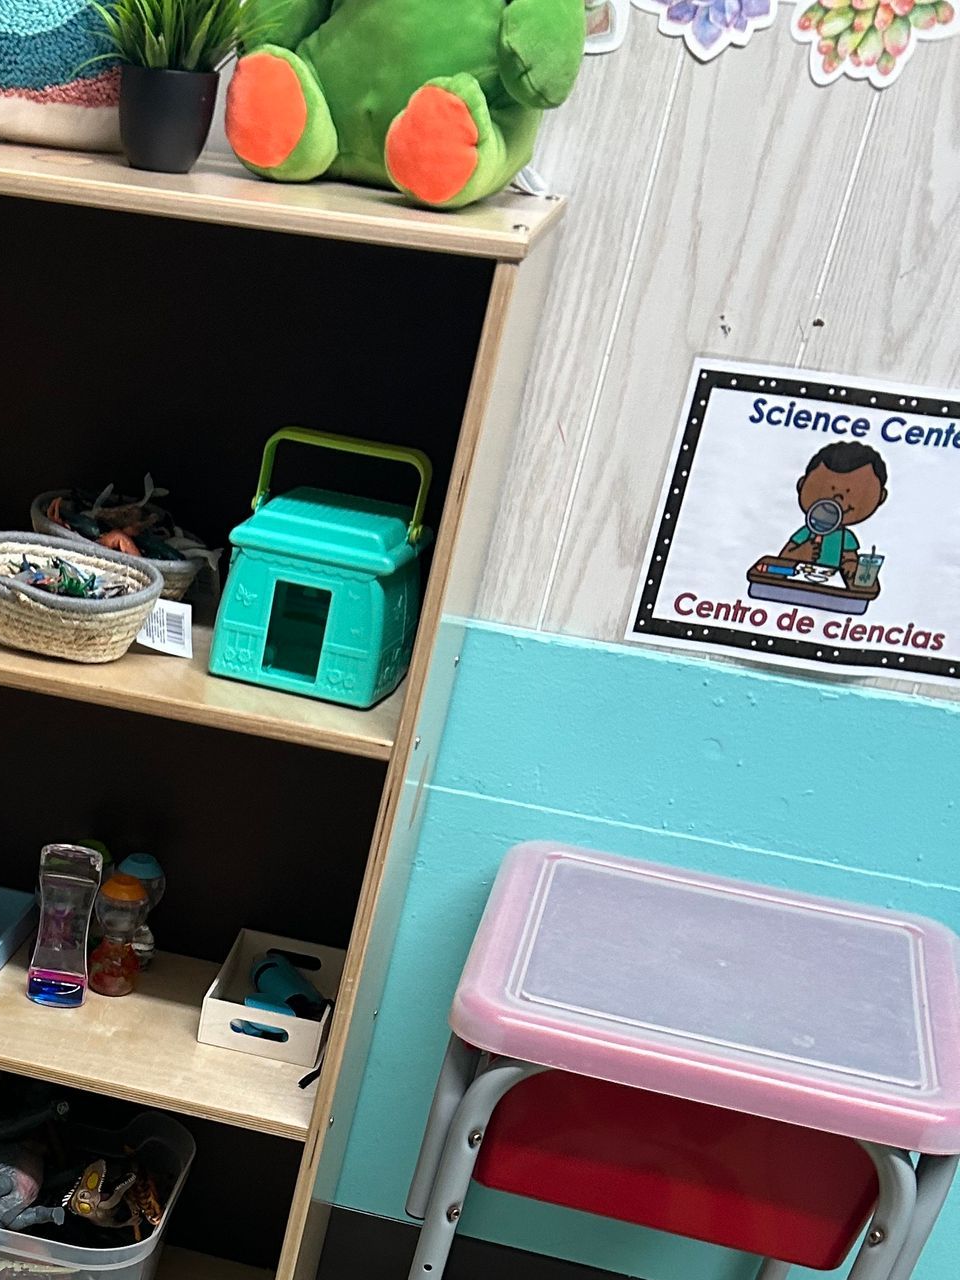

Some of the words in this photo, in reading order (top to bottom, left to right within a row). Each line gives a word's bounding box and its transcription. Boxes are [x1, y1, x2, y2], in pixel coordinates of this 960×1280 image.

[749, 397, 871, 438] Science
[673, 592, 768, 627] Centro
[776, 608, 815, 634] de
[822, 617, 946, 651] ciencias
